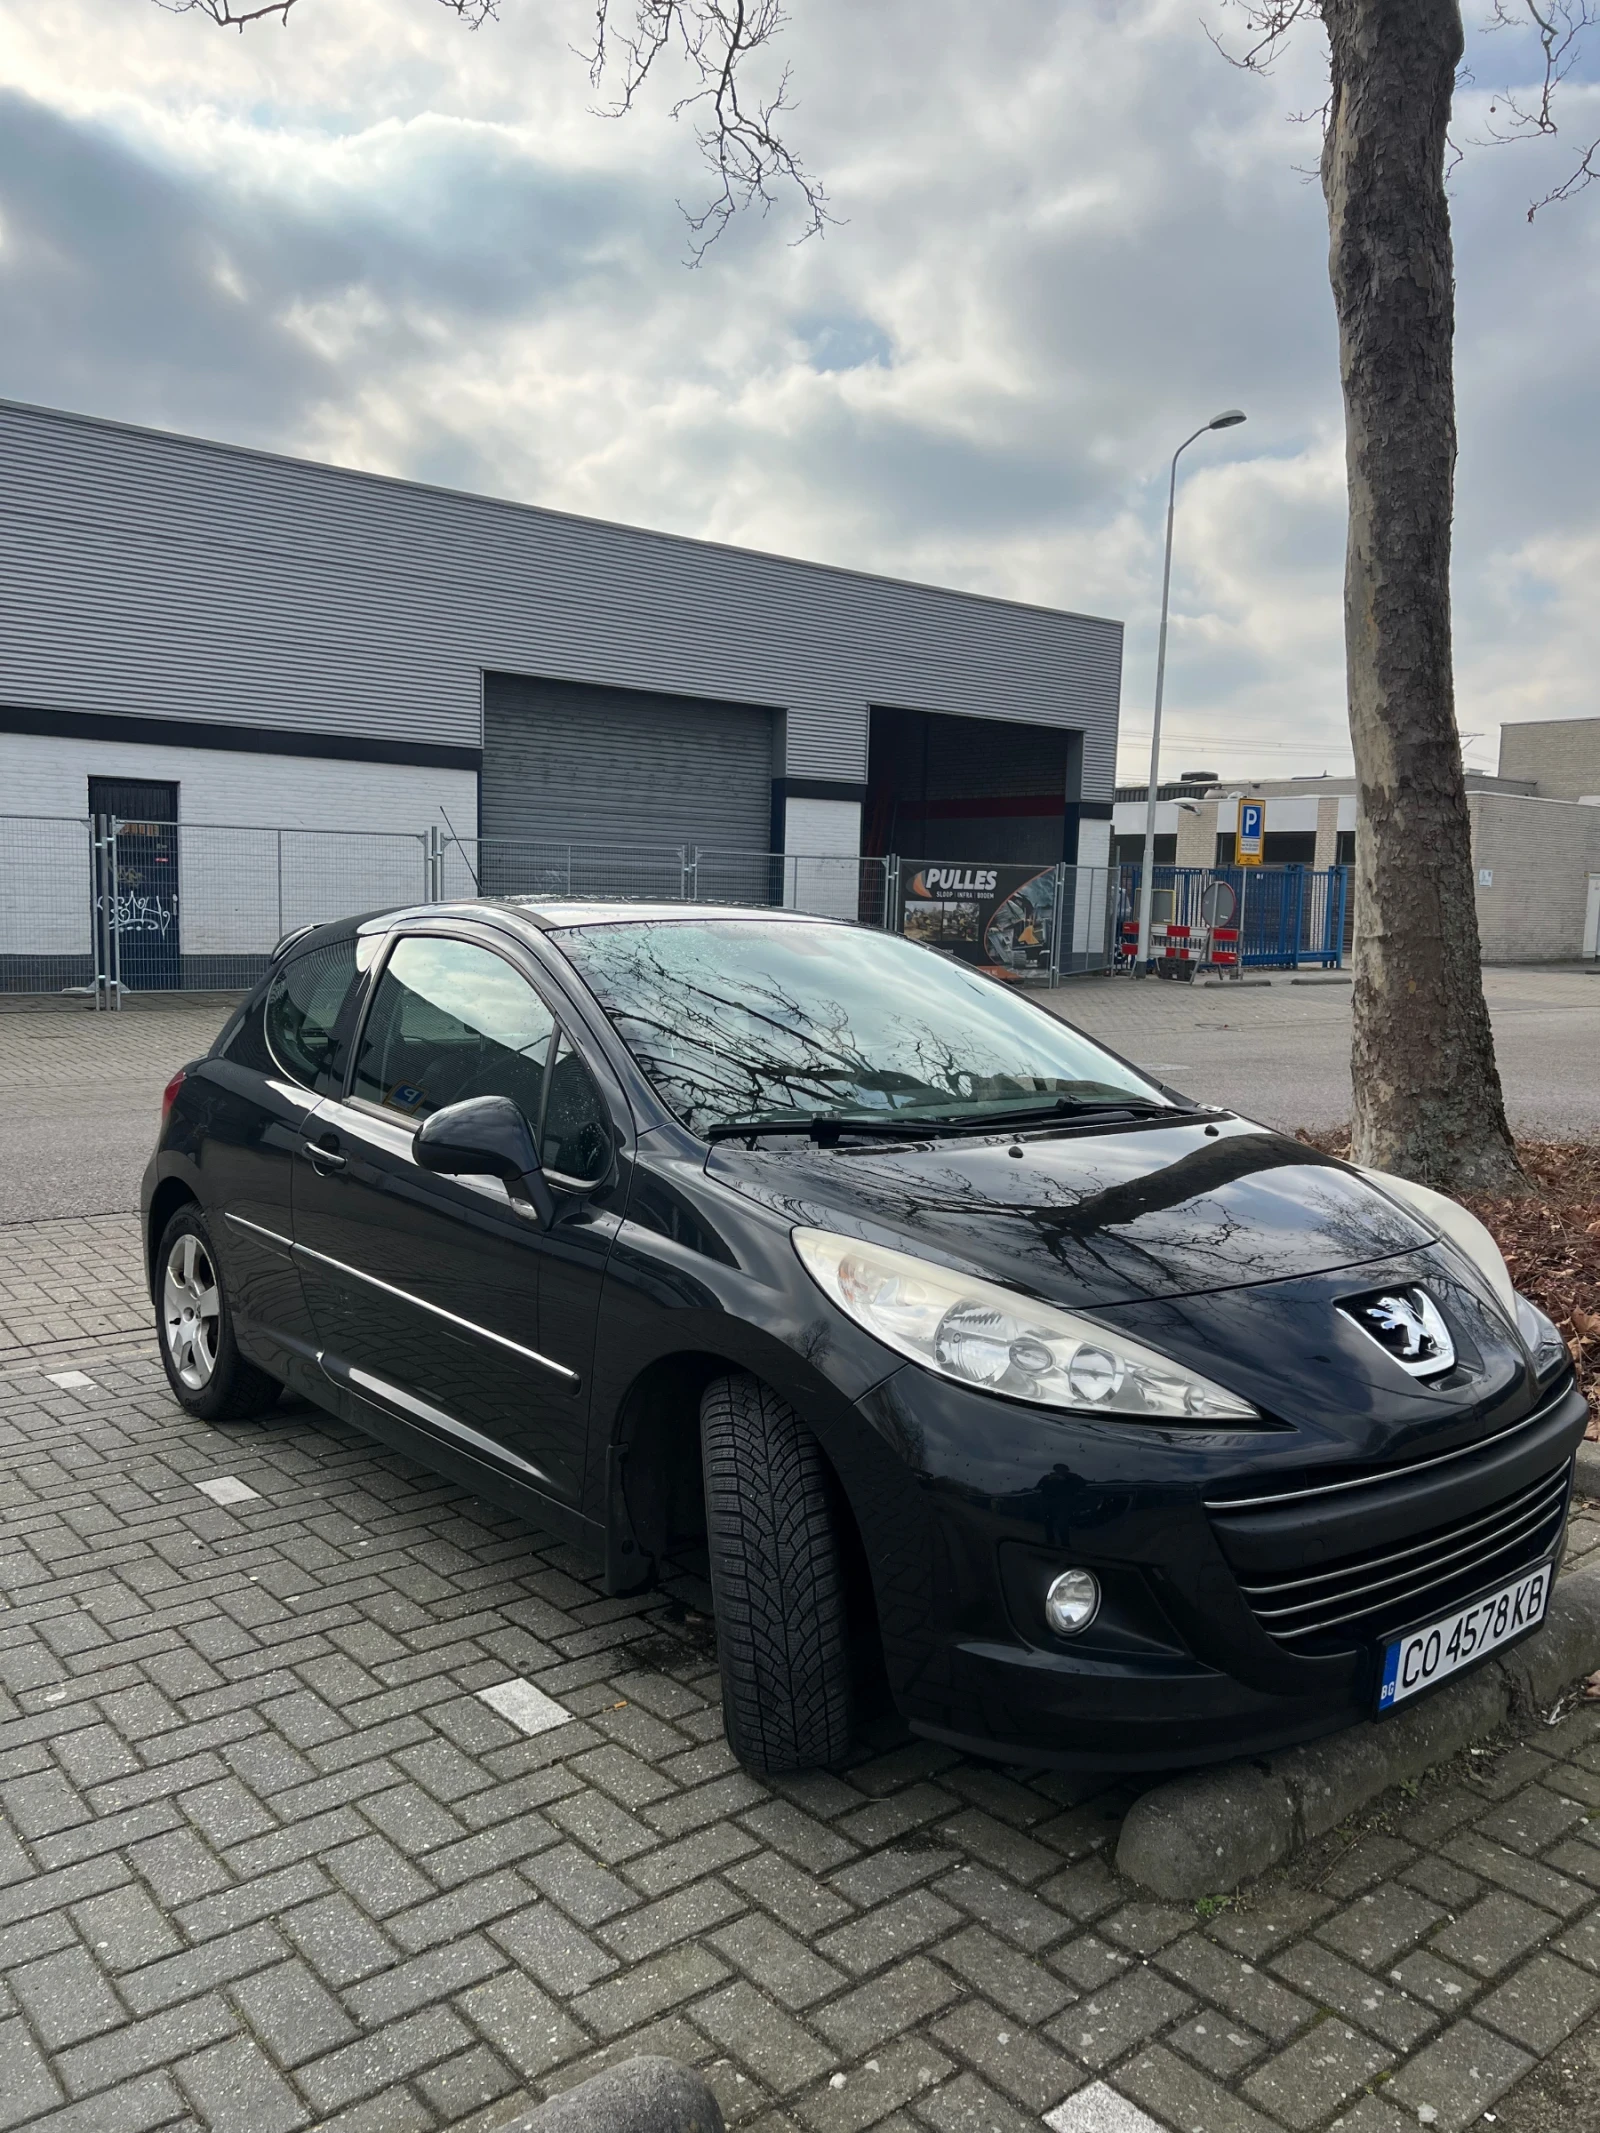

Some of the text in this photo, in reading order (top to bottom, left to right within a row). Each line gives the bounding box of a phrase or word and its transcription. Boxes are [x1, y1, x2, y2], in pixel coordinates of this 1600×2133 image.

[1245, 809, 1258, 834] P
[925, 868, 998, 891] PULLES
[957, 891, 972, 899] INFRA
[1381, 1681, 1395, 1700] BG
